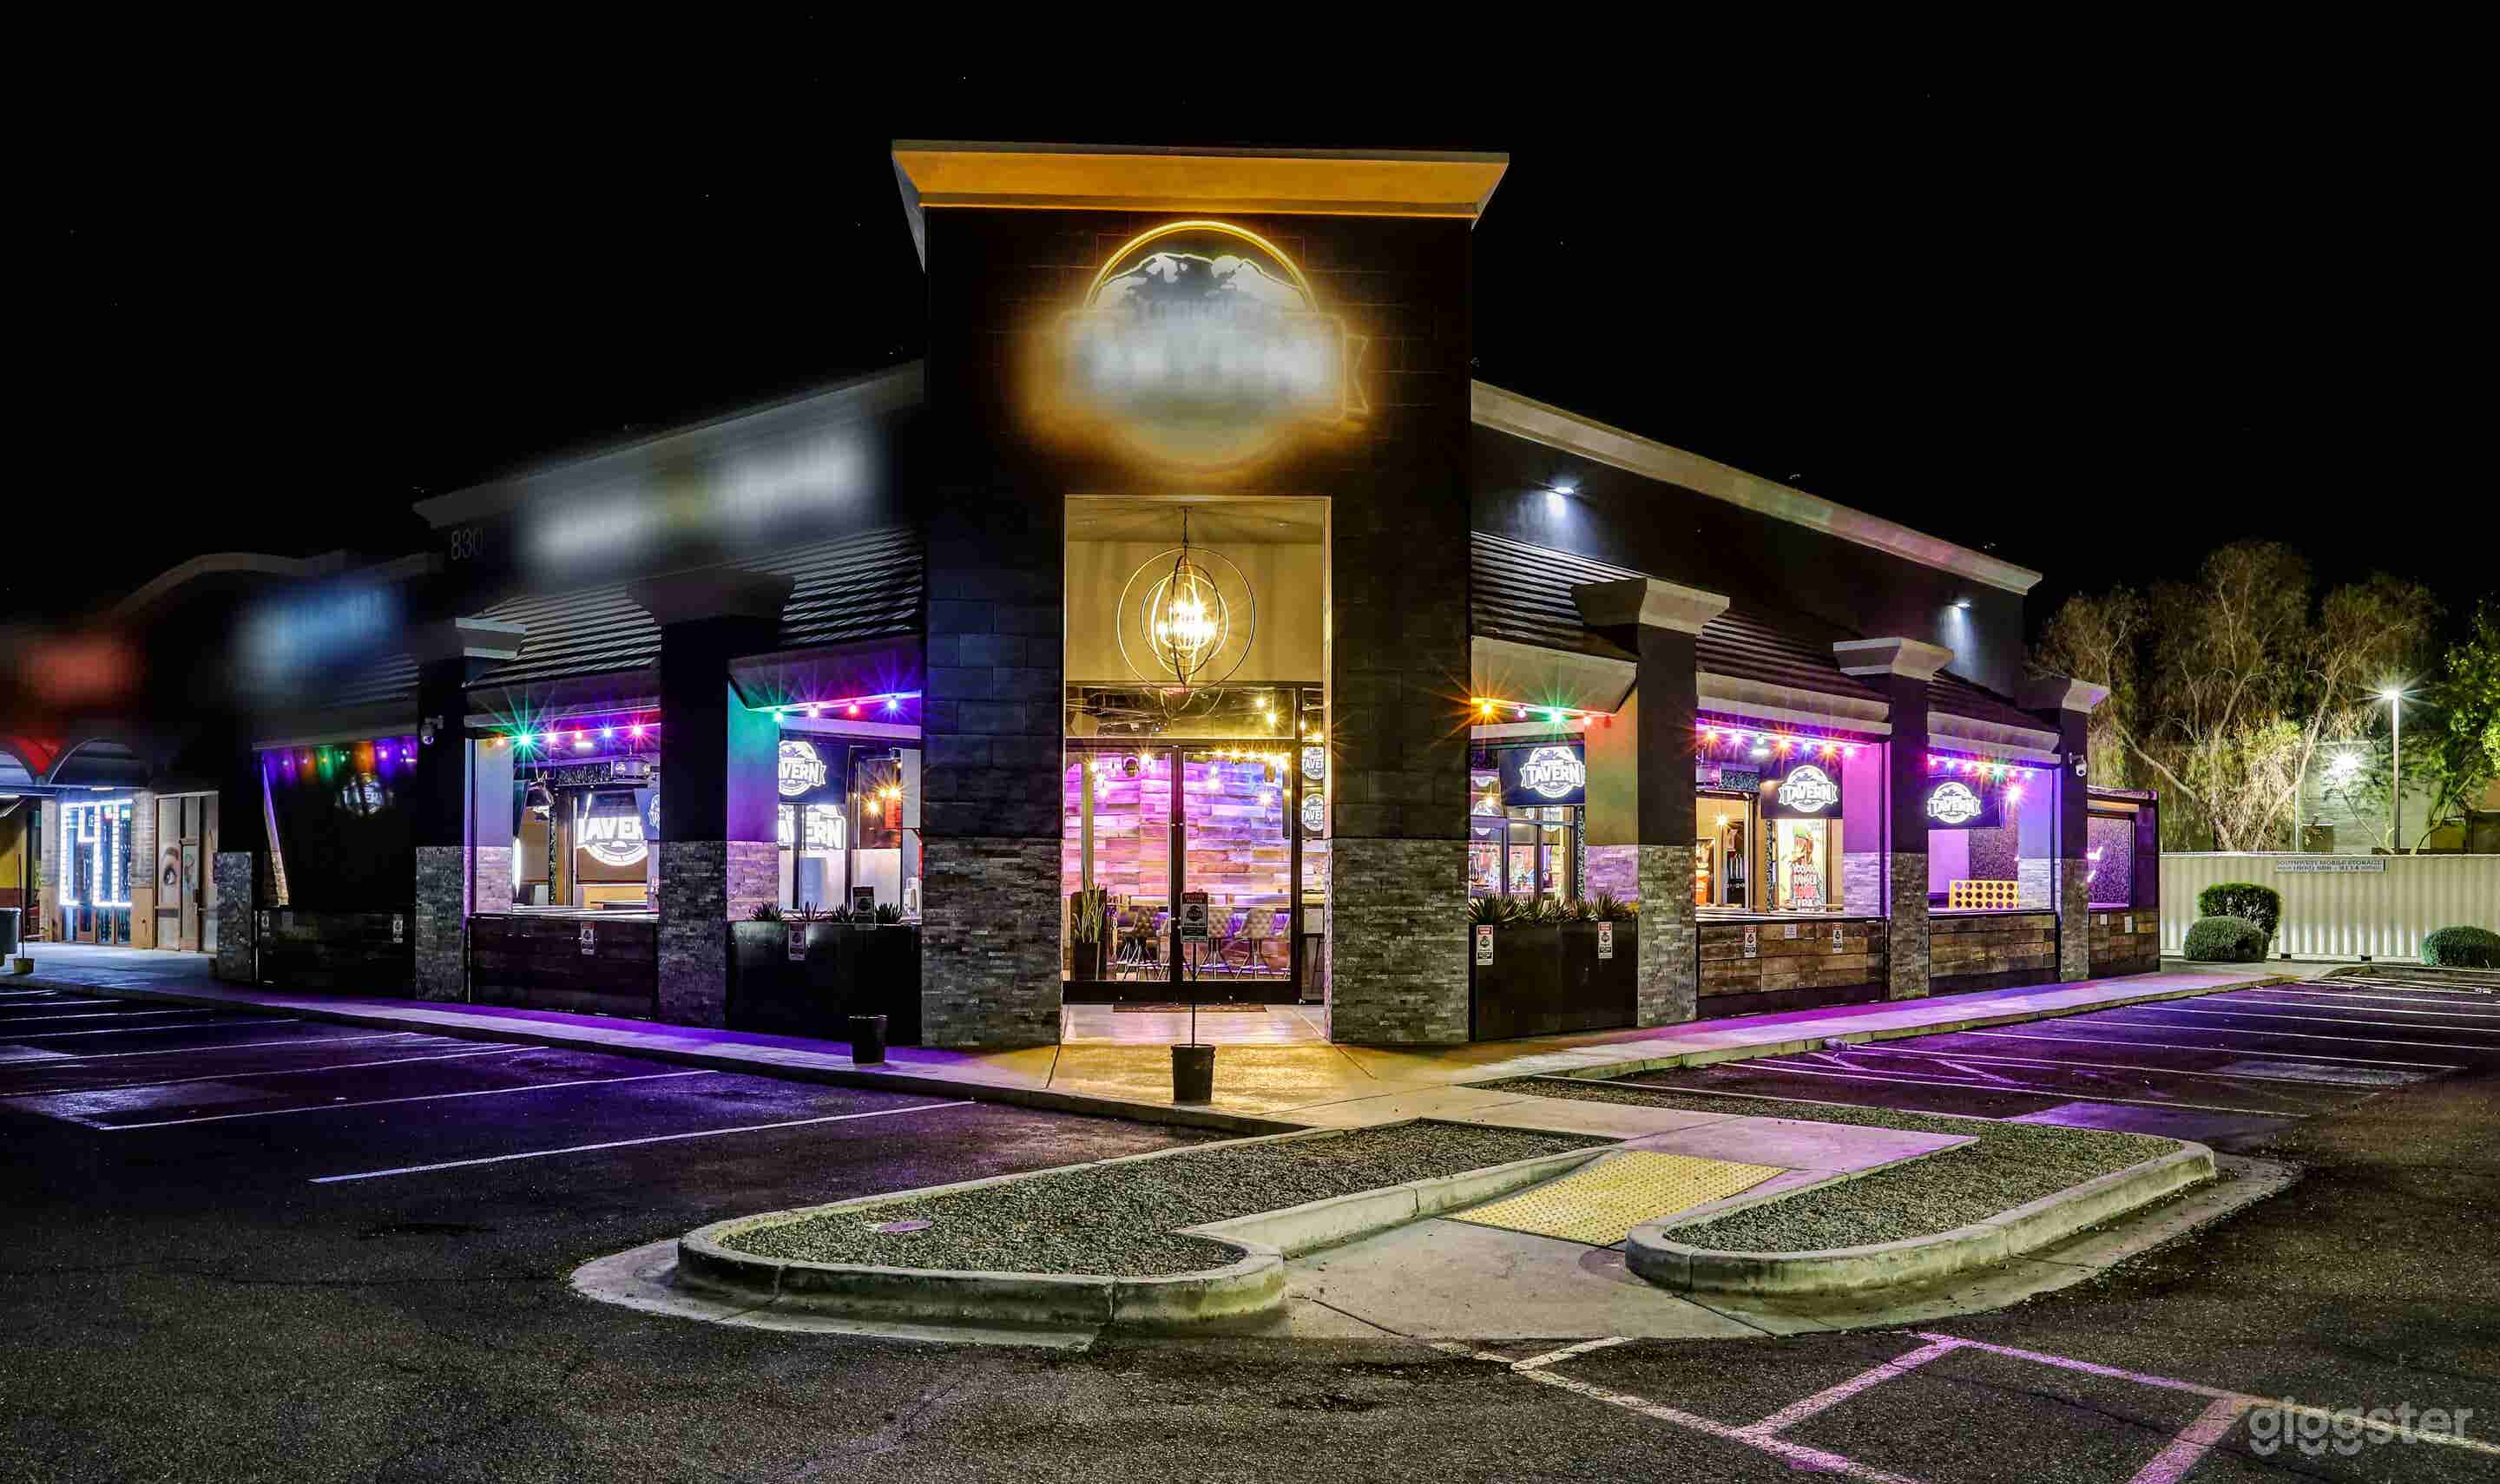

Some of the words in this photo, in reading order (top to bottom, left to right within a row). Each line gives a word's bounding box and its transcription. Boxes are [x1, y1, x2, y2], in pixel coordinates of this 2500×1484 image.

[779, 760, 820, 784] AVERN
[1301, 758, 1324, 771] TAVE
[1526, 762, 1581, 785] TAVERN
[1784, 784, 1832, 802] TAVERN
[1931, 798, 1975, 814] TAVERN
[1301, 808, 1324, 823] TAVE
[576, 816, 643, 845] TAVE
